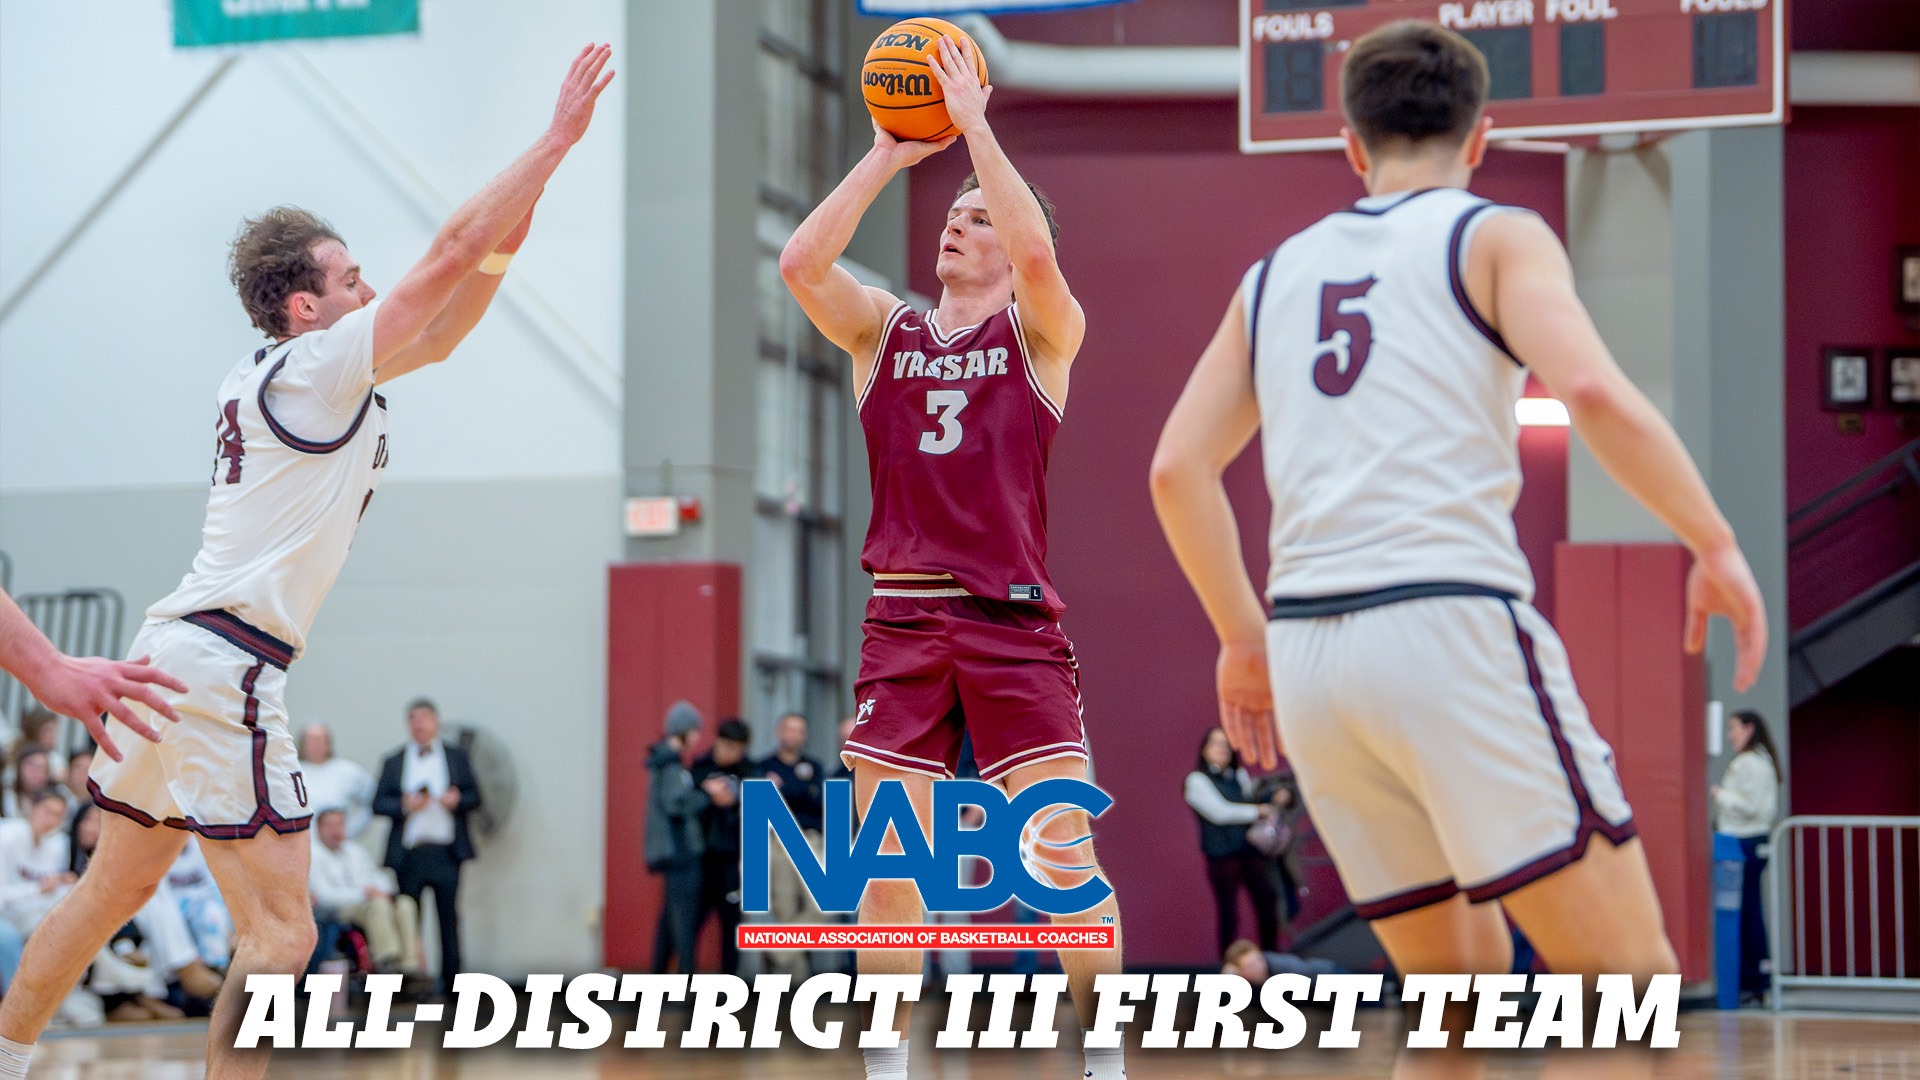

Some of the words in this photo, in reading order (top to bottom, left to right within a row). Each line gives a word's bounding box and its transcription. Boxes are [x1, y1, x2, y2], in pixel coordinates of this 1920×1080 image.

[1253, 11, 1334, 41] FOULS
[1439, 2, 1534, 29] PLAYER
[1545, 0, 1618, 22] FOUL
[875, 33, 930, 51] NCAA
[864, 71, 932, 96] Wilson
[1313, 277, 1377, 397] 5
[893, 347, 1009, 380] VASSAR
[918, 390, 969, 455] 3
